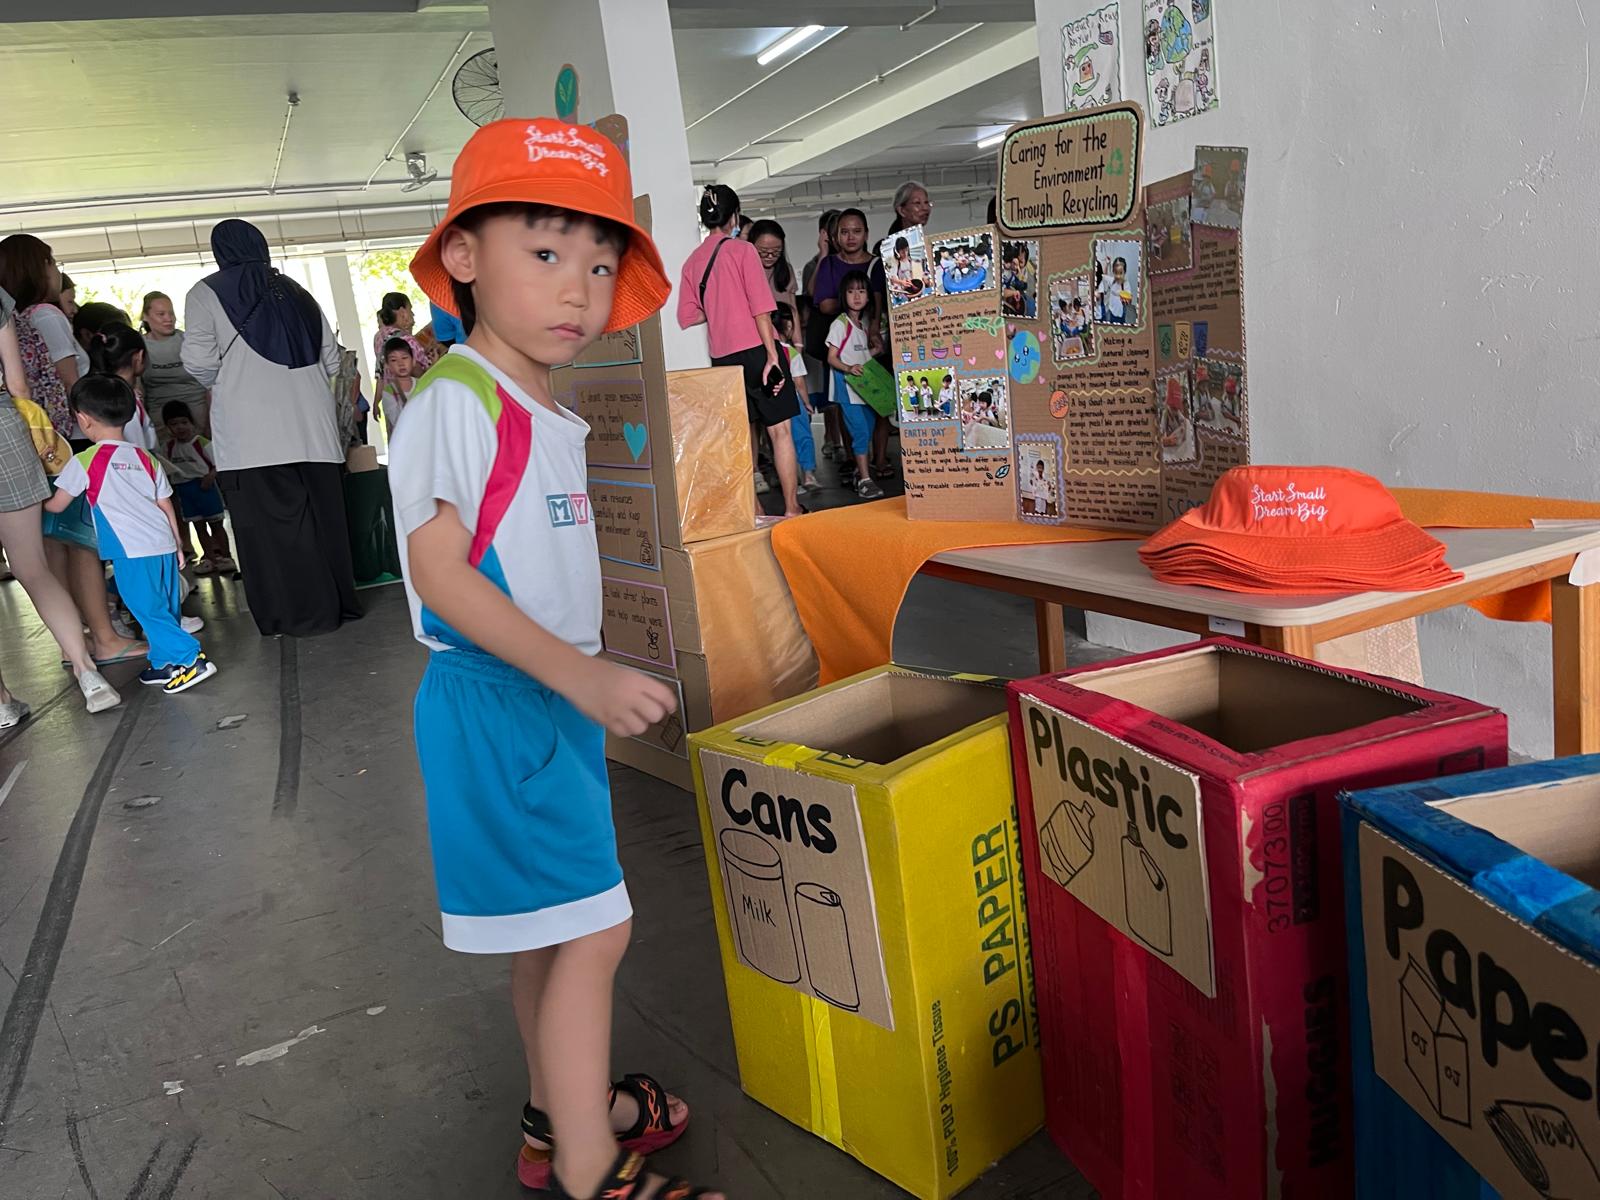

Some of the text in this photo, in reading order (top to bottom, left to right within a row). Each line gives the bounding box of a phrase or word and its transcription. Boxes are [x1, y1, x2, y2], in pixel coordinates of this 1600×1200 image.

[524, 124, 606, 159] Start Small
[1010, 123, 1108, 168] Caring for the
[528, 143, 610, 177] Dream Big
[1033, 154, 1105, 190] Environment
[1006, 184, 1119, 224] Through Recycling
[1102, 348, 1149, 361] natural cleaning
[1103, 338, 1125, 347] Making
[1078, 397, 1087, 409] big
[904, 428, 946, 438] EARTH DAY
[918, 438, 938, 447] 2026
[906, 448, 922, 458] Using
[931, 448, 946, 456] small
[939, 457, 952, 466] wipe
[992, 456, 1008, 464] using
[948, 465, 969, 474] washing
[909, 482, 925, 491] Using
[927, 481, 949, 489] reusable
[983, 479, 991, 487] for
[1251, 482, 1327, 504] Start Small
[549, 497, 586, 525] MY
[1254, 502, 1329, 522] Dream Big
[1029, 706, 1188, 849] Plastic
[721, 767, 838, 854] Cans
[743, 894, 777, 928] Milk
[971, 822, 1024, 1070] PS PAPER
[1382, 856, 1600, 1118] Pape
[932, 999, 944, 1048] Tissue
[1411, 1031, 1428, 1056] OJ
[936, 1044, 952, 1102] Hygiene
[1444, 1065, 1461, 1087] OJ
[1522, 1106, 1575, 1150] News
